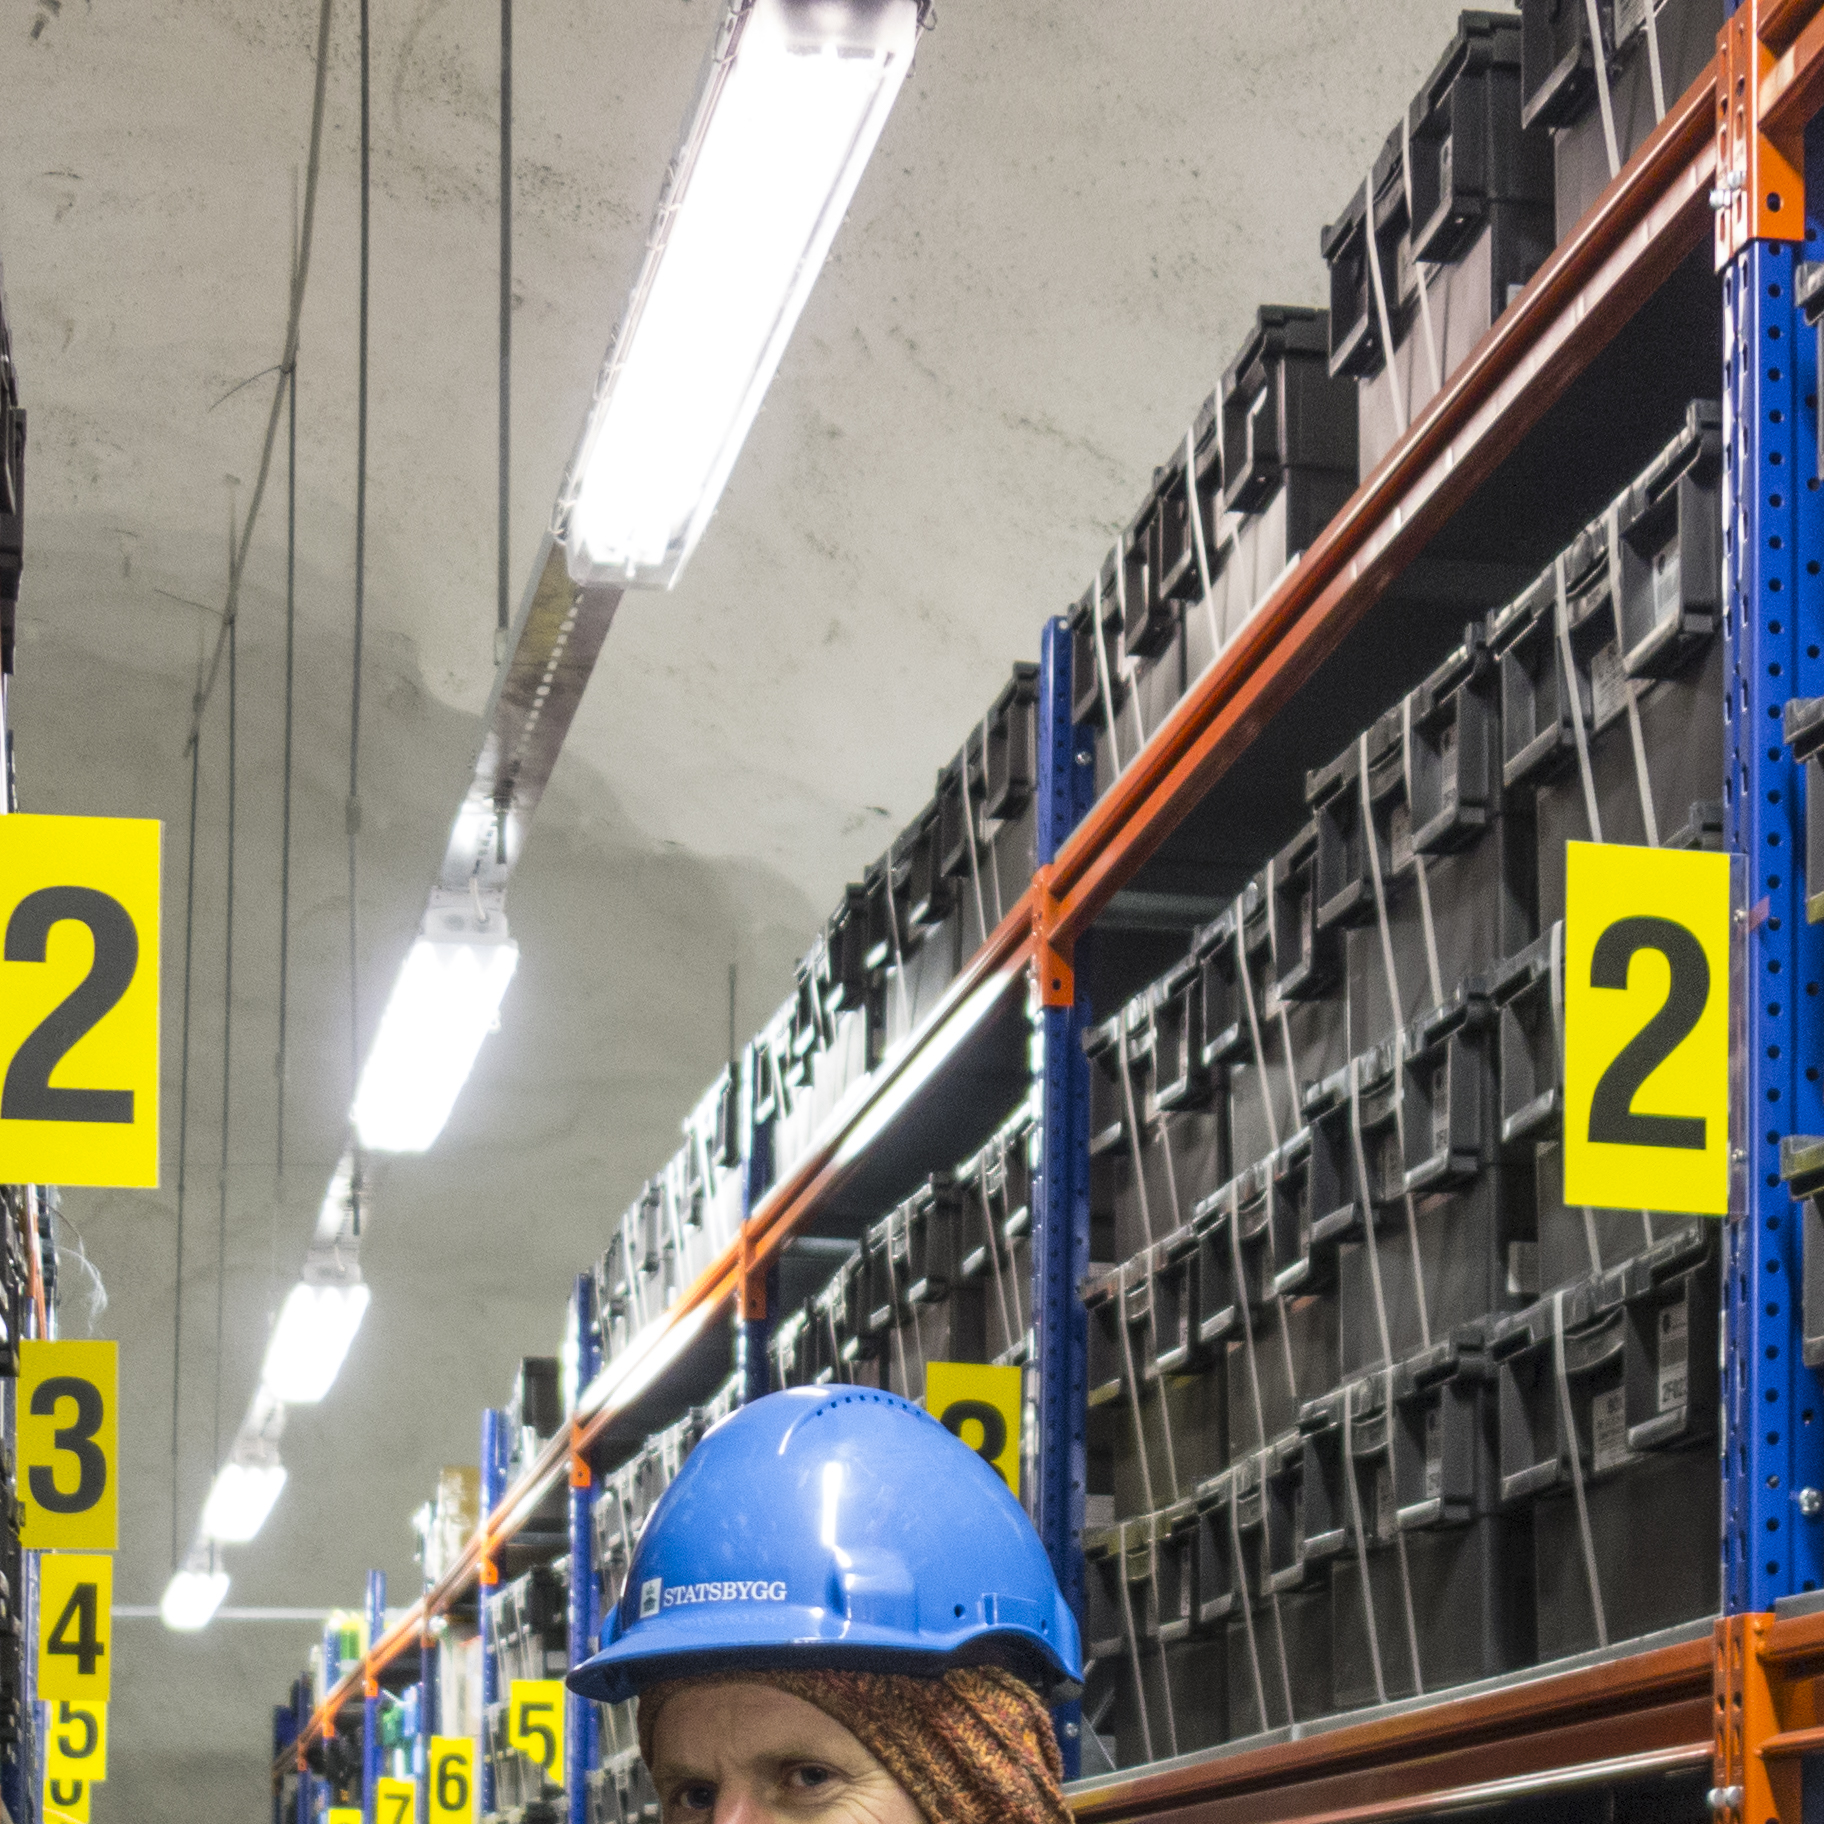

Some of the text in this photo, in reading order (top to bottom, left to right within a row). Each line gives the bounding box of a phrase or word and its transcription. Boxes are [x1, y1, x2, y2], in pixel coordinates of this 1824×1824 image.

[0, 885, 140, 1125] 2
[1587, 913, 1711, 1151] 2
[28, 1375, 107, 1514] 3
[47, 1582, 105, 1675] 4
[663, 1580, 788, 1608] STATSBYGG
[57, 1701, 99, 1759] 5
[517, 1701, 557, 1770] 5
[435, 1752, 469, 1813] 6
